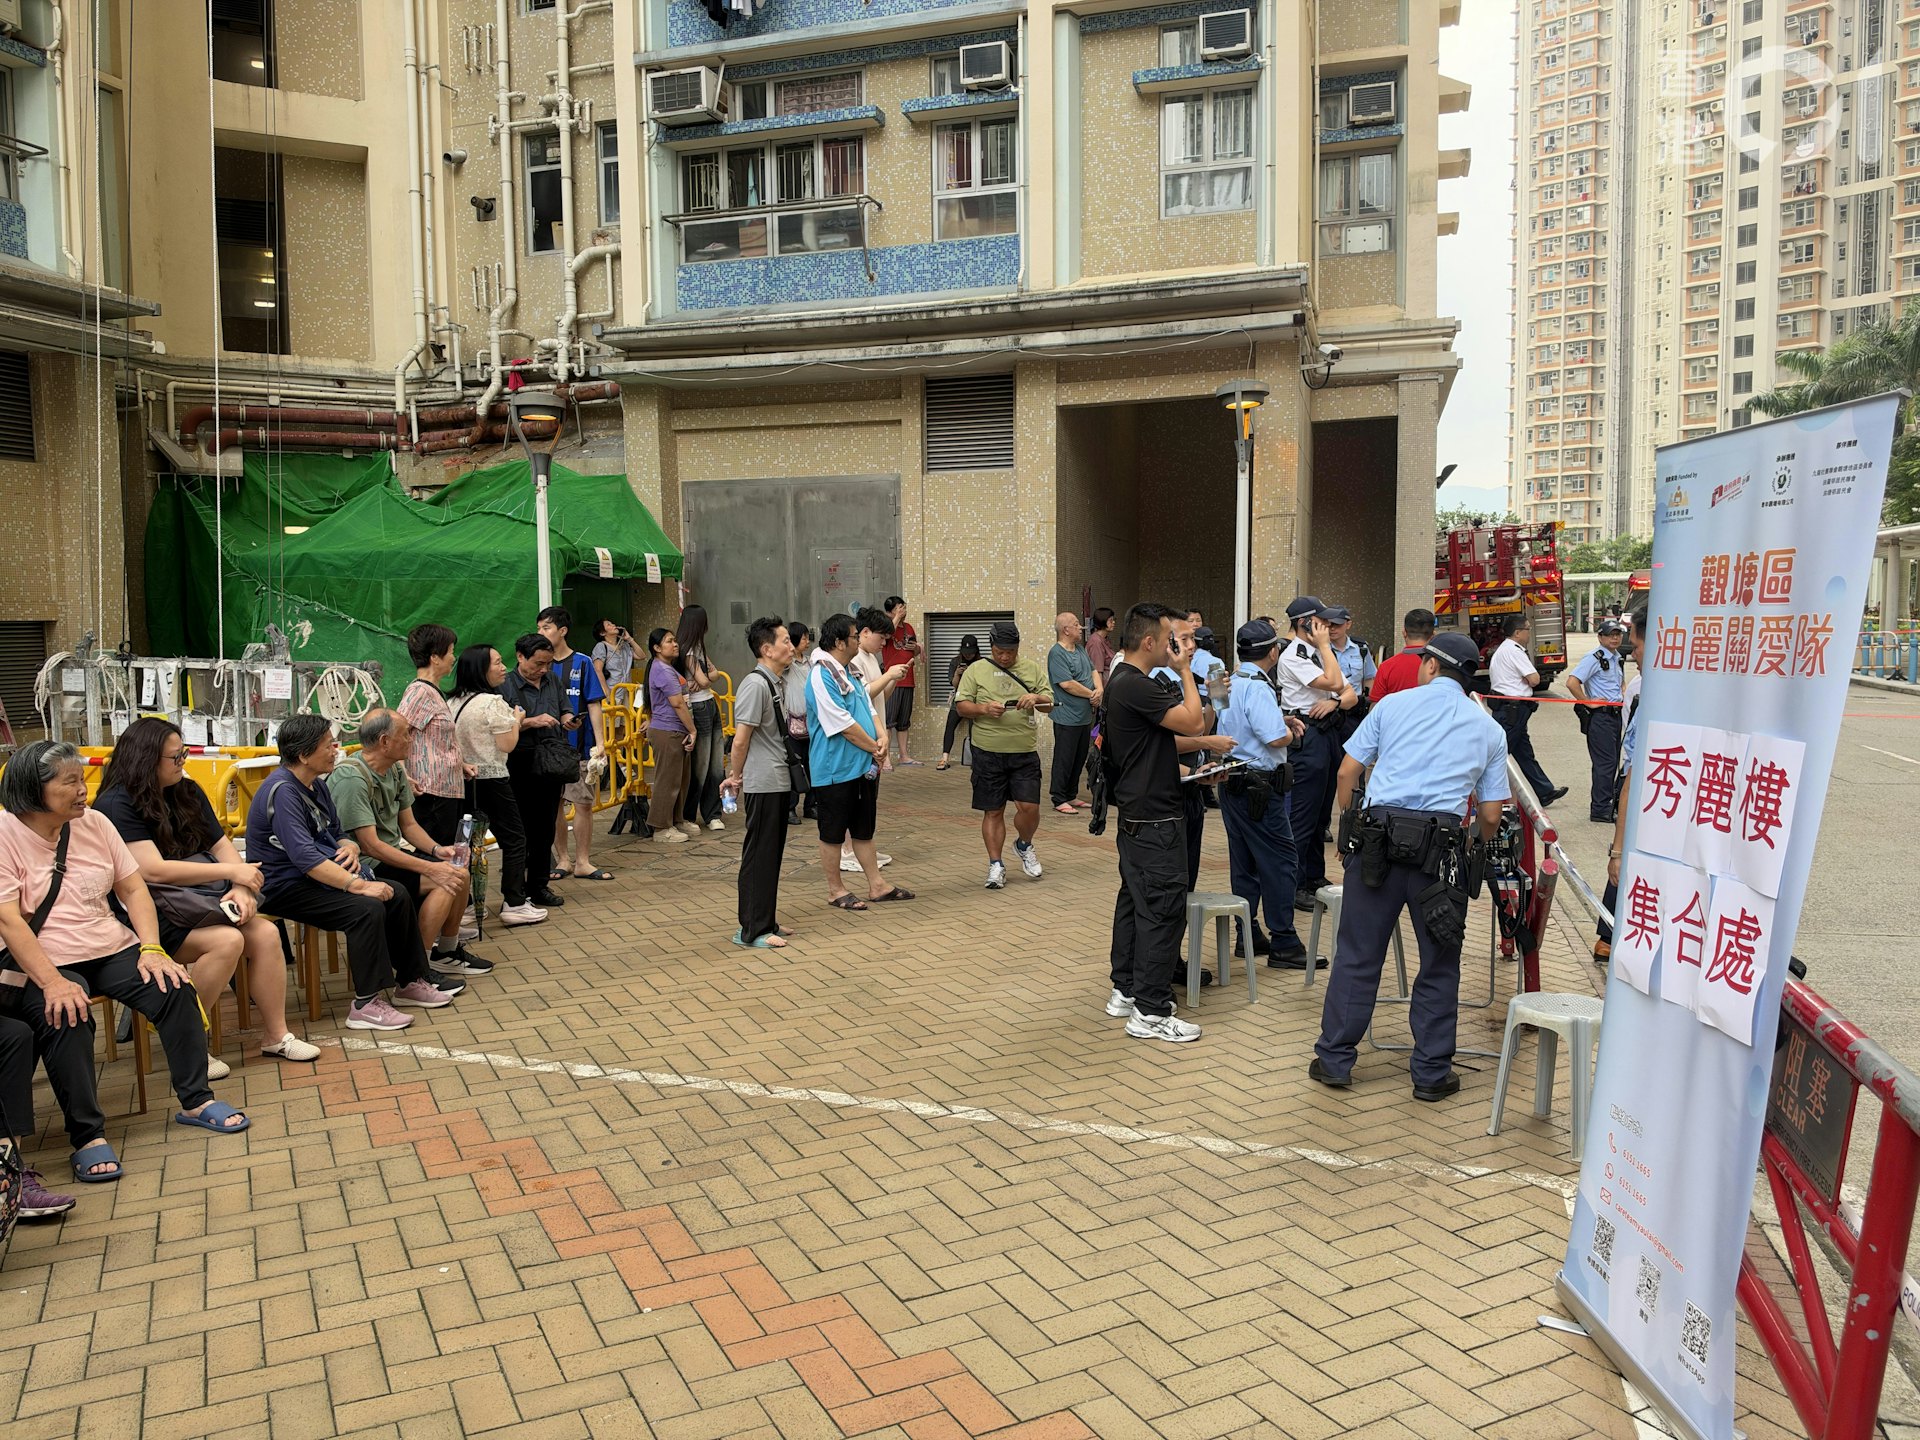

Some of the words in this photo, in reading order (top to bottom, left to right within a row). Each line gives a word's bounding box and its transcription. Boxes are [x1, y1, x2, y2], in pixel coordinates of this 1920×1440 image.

[1699, 548, 1797, 607] 觀塘區
[1653, 613, 1835, 678] 油麗關愛隊
[1643, 745, 1791, 850] 秀麗樓
[1624, 874, 1763, 996] 集合處
[1776, 1085, 1807, 1135] CLEAR
[1622, 1149, 1636, 1166] 6151
[1810, 1166, 1833, 1197] ACCESS
[1678, 1351, 1706, 1386] WhatsApp
